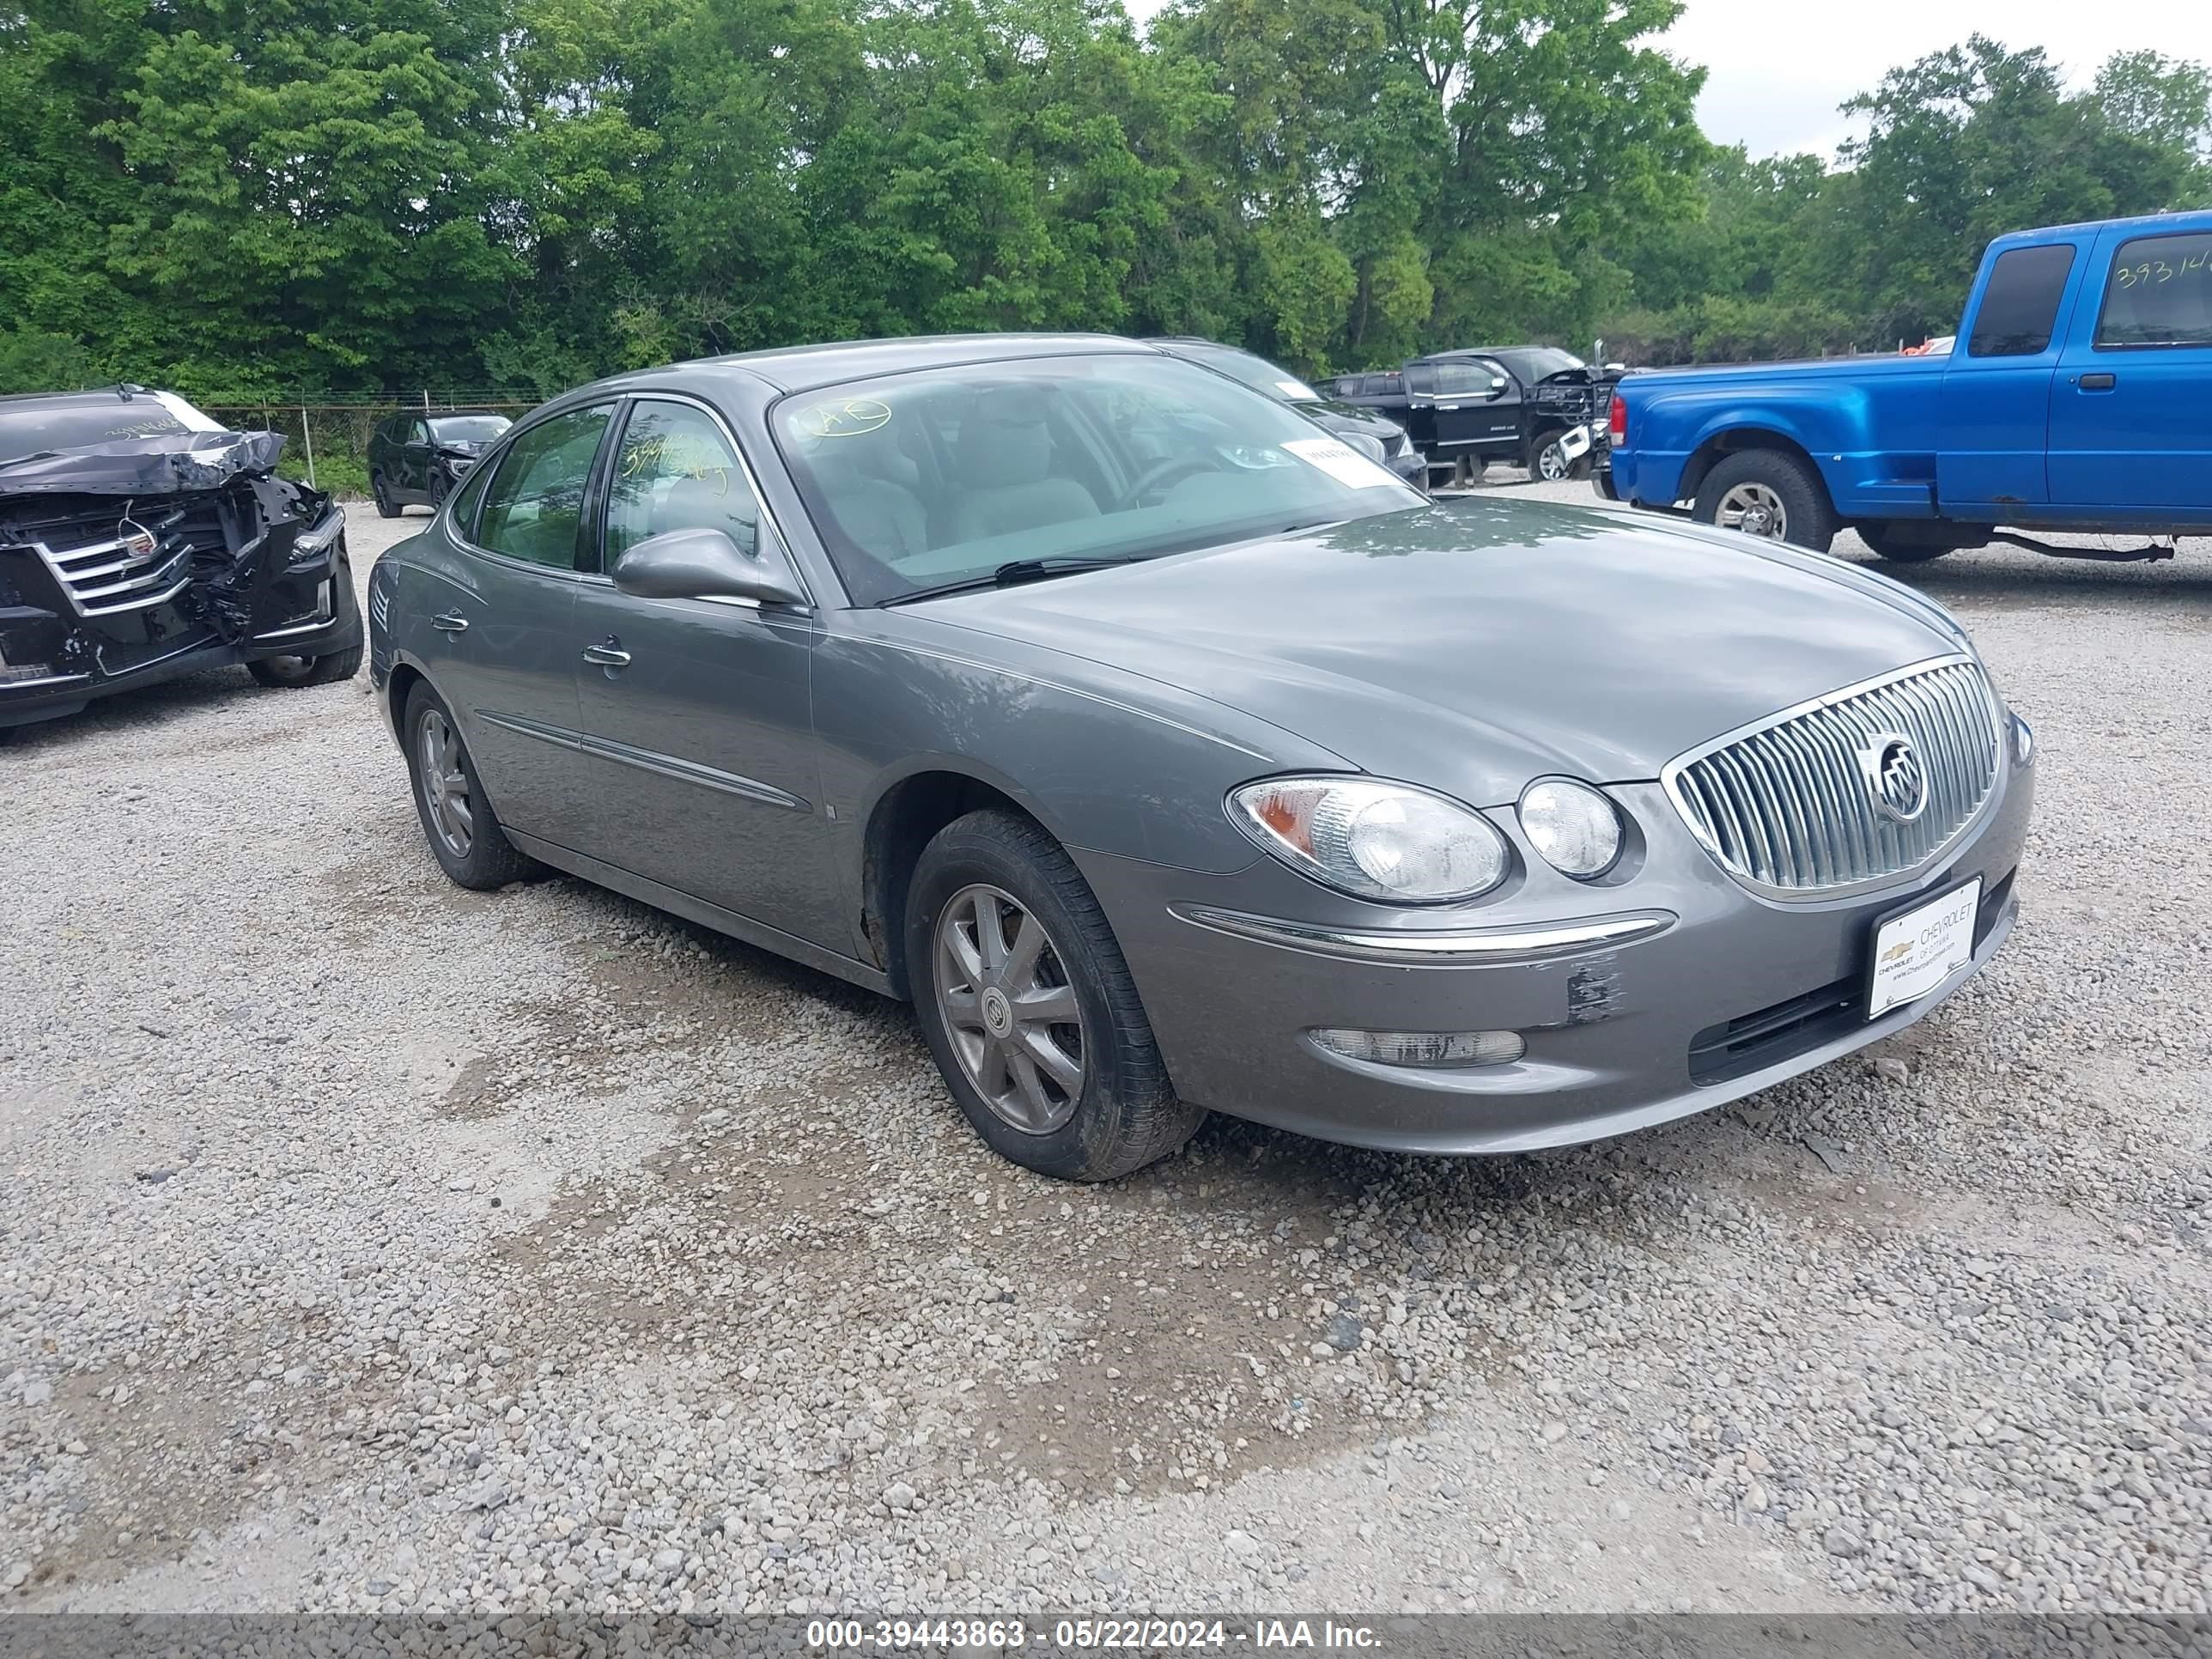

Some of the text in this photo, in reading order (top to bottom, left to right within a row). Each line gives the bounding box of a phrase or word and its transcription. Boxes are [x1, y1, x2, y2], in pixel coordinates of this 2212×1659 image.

[2118, 249, 2212, 289] 39314
[1920, 902, 1972, 945] CHEVROLET
[1878, 956, 1914, 976] CHEVROLET
